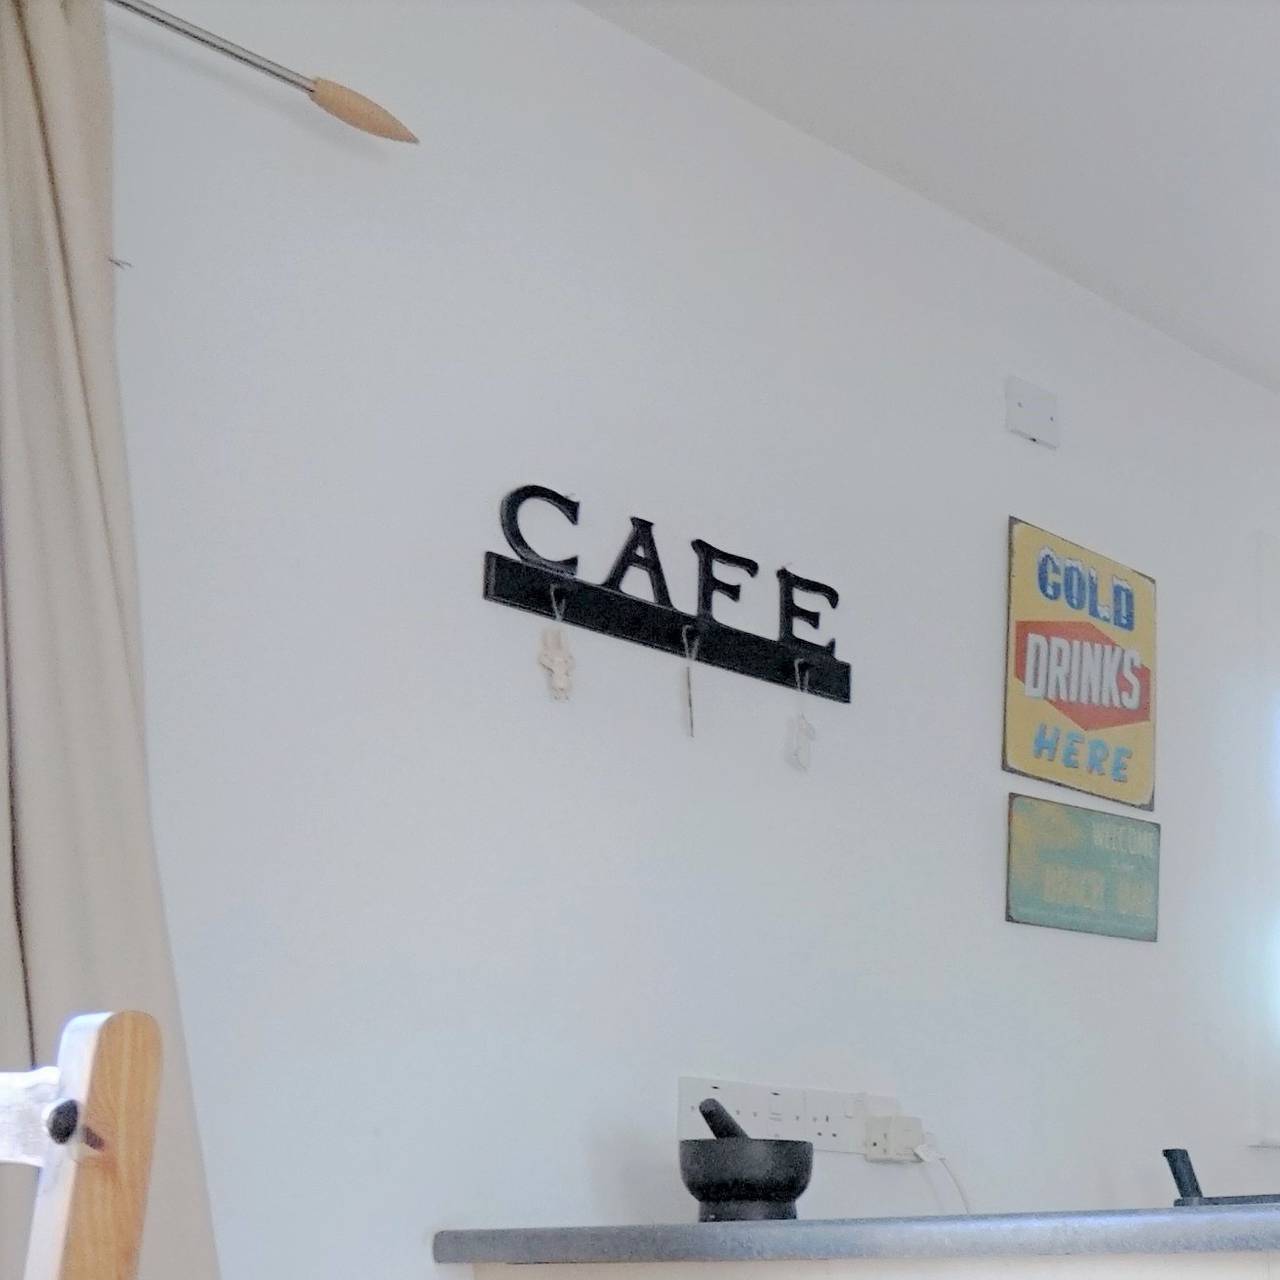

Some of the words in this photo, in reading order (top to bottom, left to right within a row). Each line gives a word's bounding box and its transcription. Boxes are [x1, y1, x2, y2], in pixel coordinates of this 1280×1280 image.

[500, 484, 839, 658] CAFE
[1037, 547, 1134, 631] COLD
[1025, 632, 1141, 711] DRINKS
[1032, 721, 1133, 783] HERE
